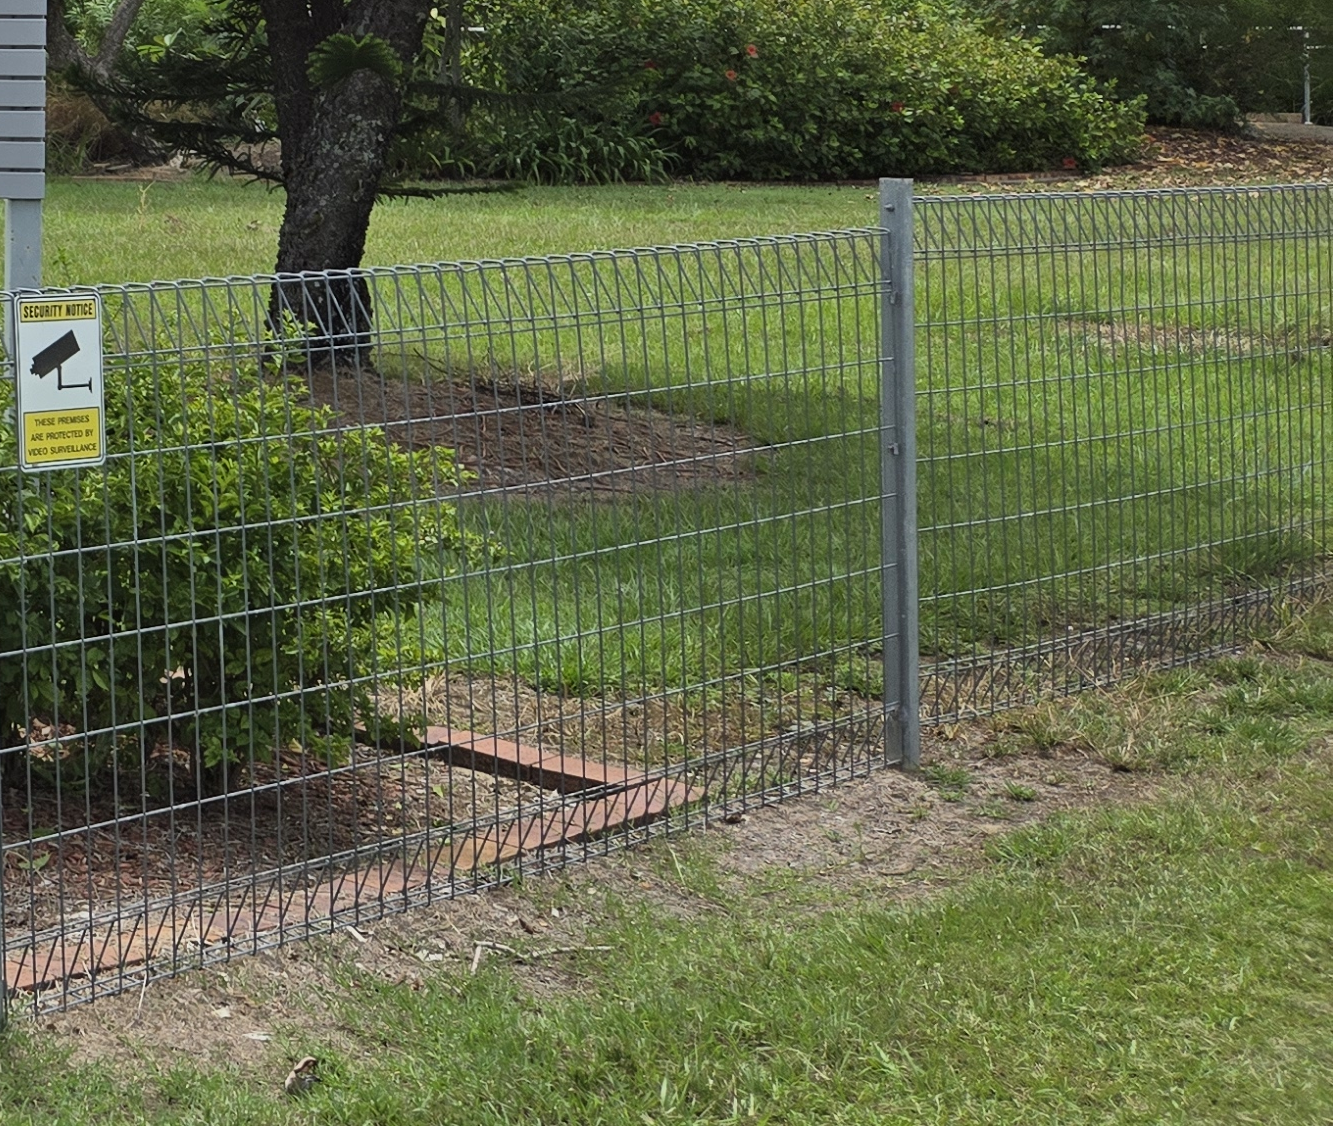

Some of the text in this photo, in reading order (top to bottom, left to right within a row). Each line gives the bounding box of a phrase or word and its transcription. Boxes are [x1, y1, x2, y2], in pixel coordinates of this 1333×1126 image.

[23, 302, 93, 319] SECURITY NOTICE
[34, 414, 90, 427] THESE PREMISES
[30, 428, 94, 442] ARE PROTECTED BY
[27, 442, 97, 456] VIDEO SURVEILLANCE
